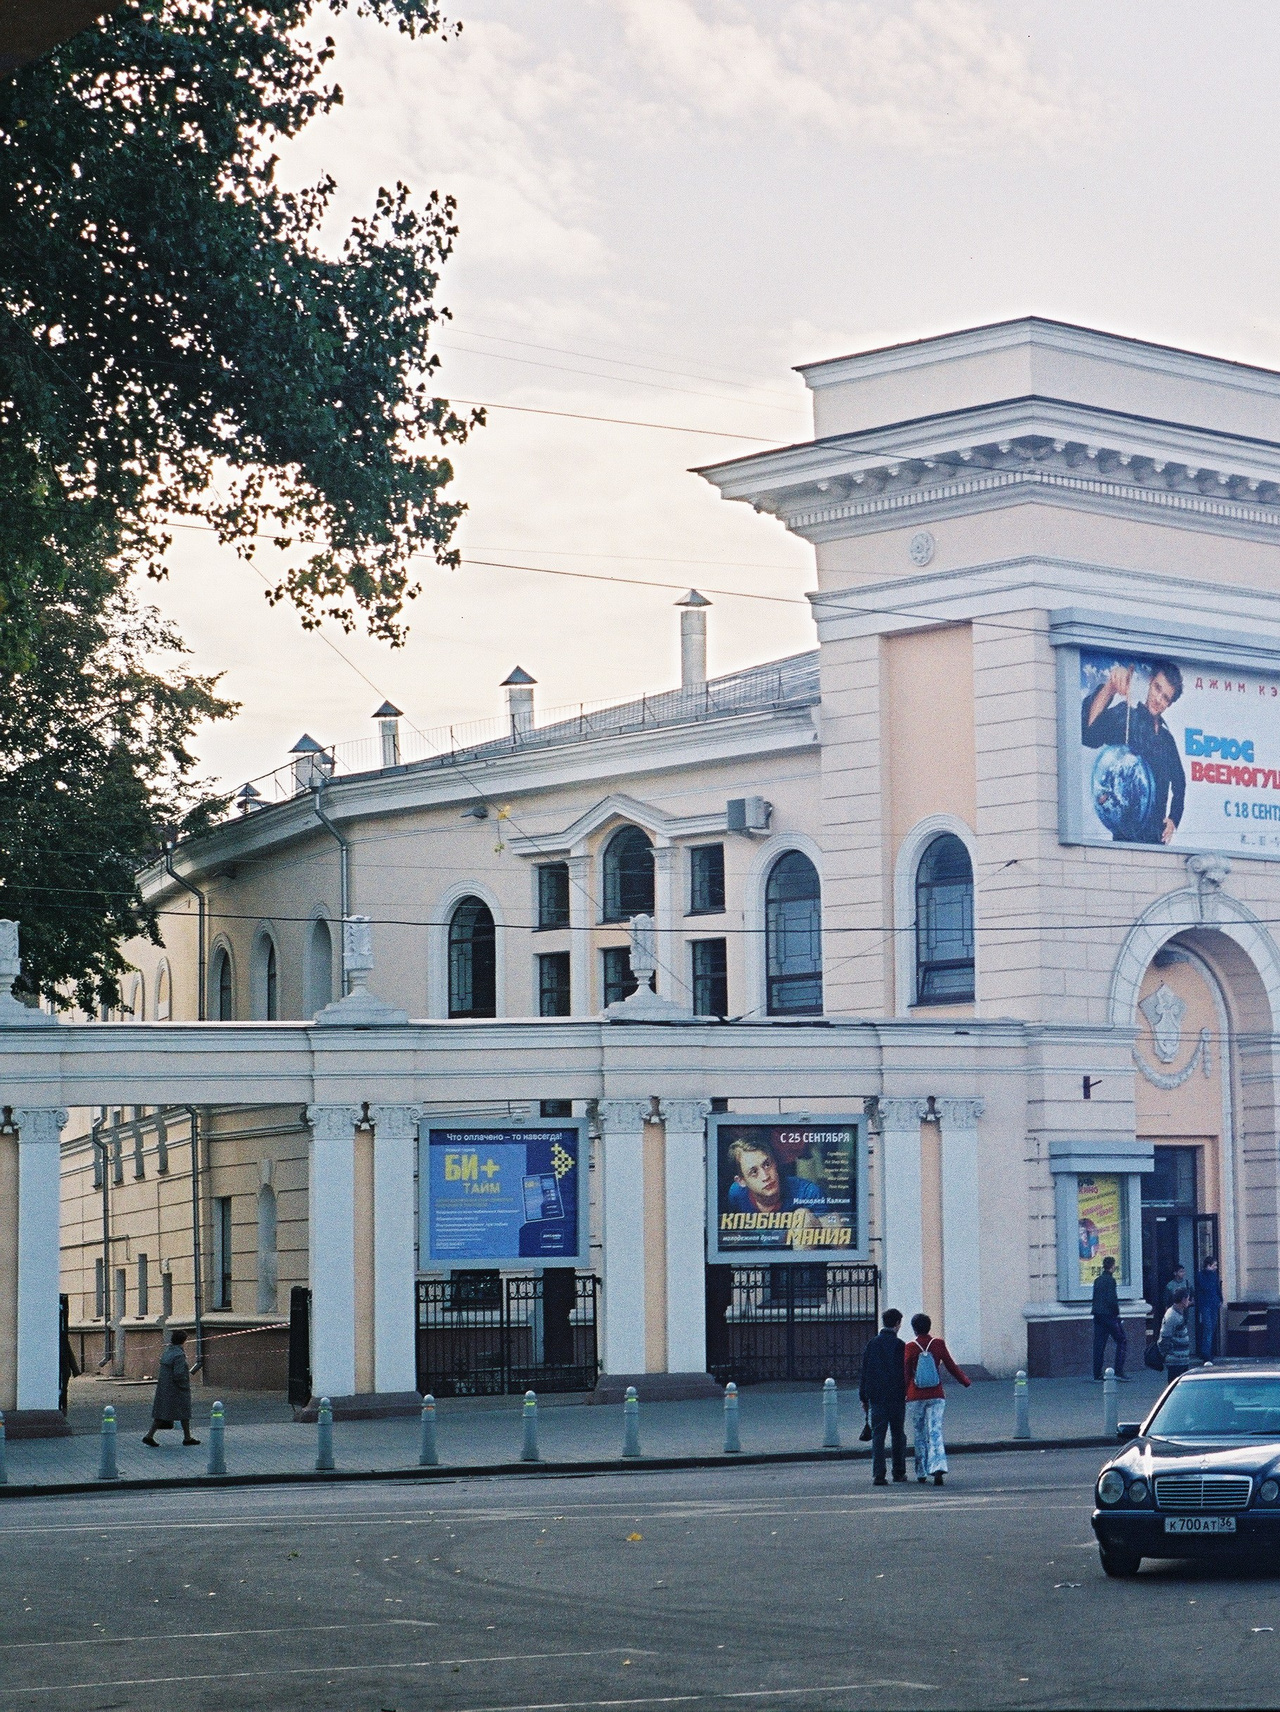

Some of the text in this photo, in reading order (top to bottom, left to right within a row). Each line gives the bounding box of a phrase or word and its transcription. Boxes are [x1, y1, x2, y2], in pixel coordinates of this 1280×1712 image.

[1195, 677, 1245, 693] ДЖИМ
[1224, 800, 1231, 817] С
[1235, 801, 1249, 818] 18
[447, 1133, 462, 1141] Что
[523, 1132, 563, 1141] навсегда!
[780, 1132, 850, 1143] С 25 СЕНТЯБРЯ
[463, 1181, 500, 1194] ТАЙМ
[721, 1210, 807, 1230] КЛУБНАЯ
[786, 1227, 852, 1246] МАНИЯ
[1220, 1517, 1232, 1527] 36
